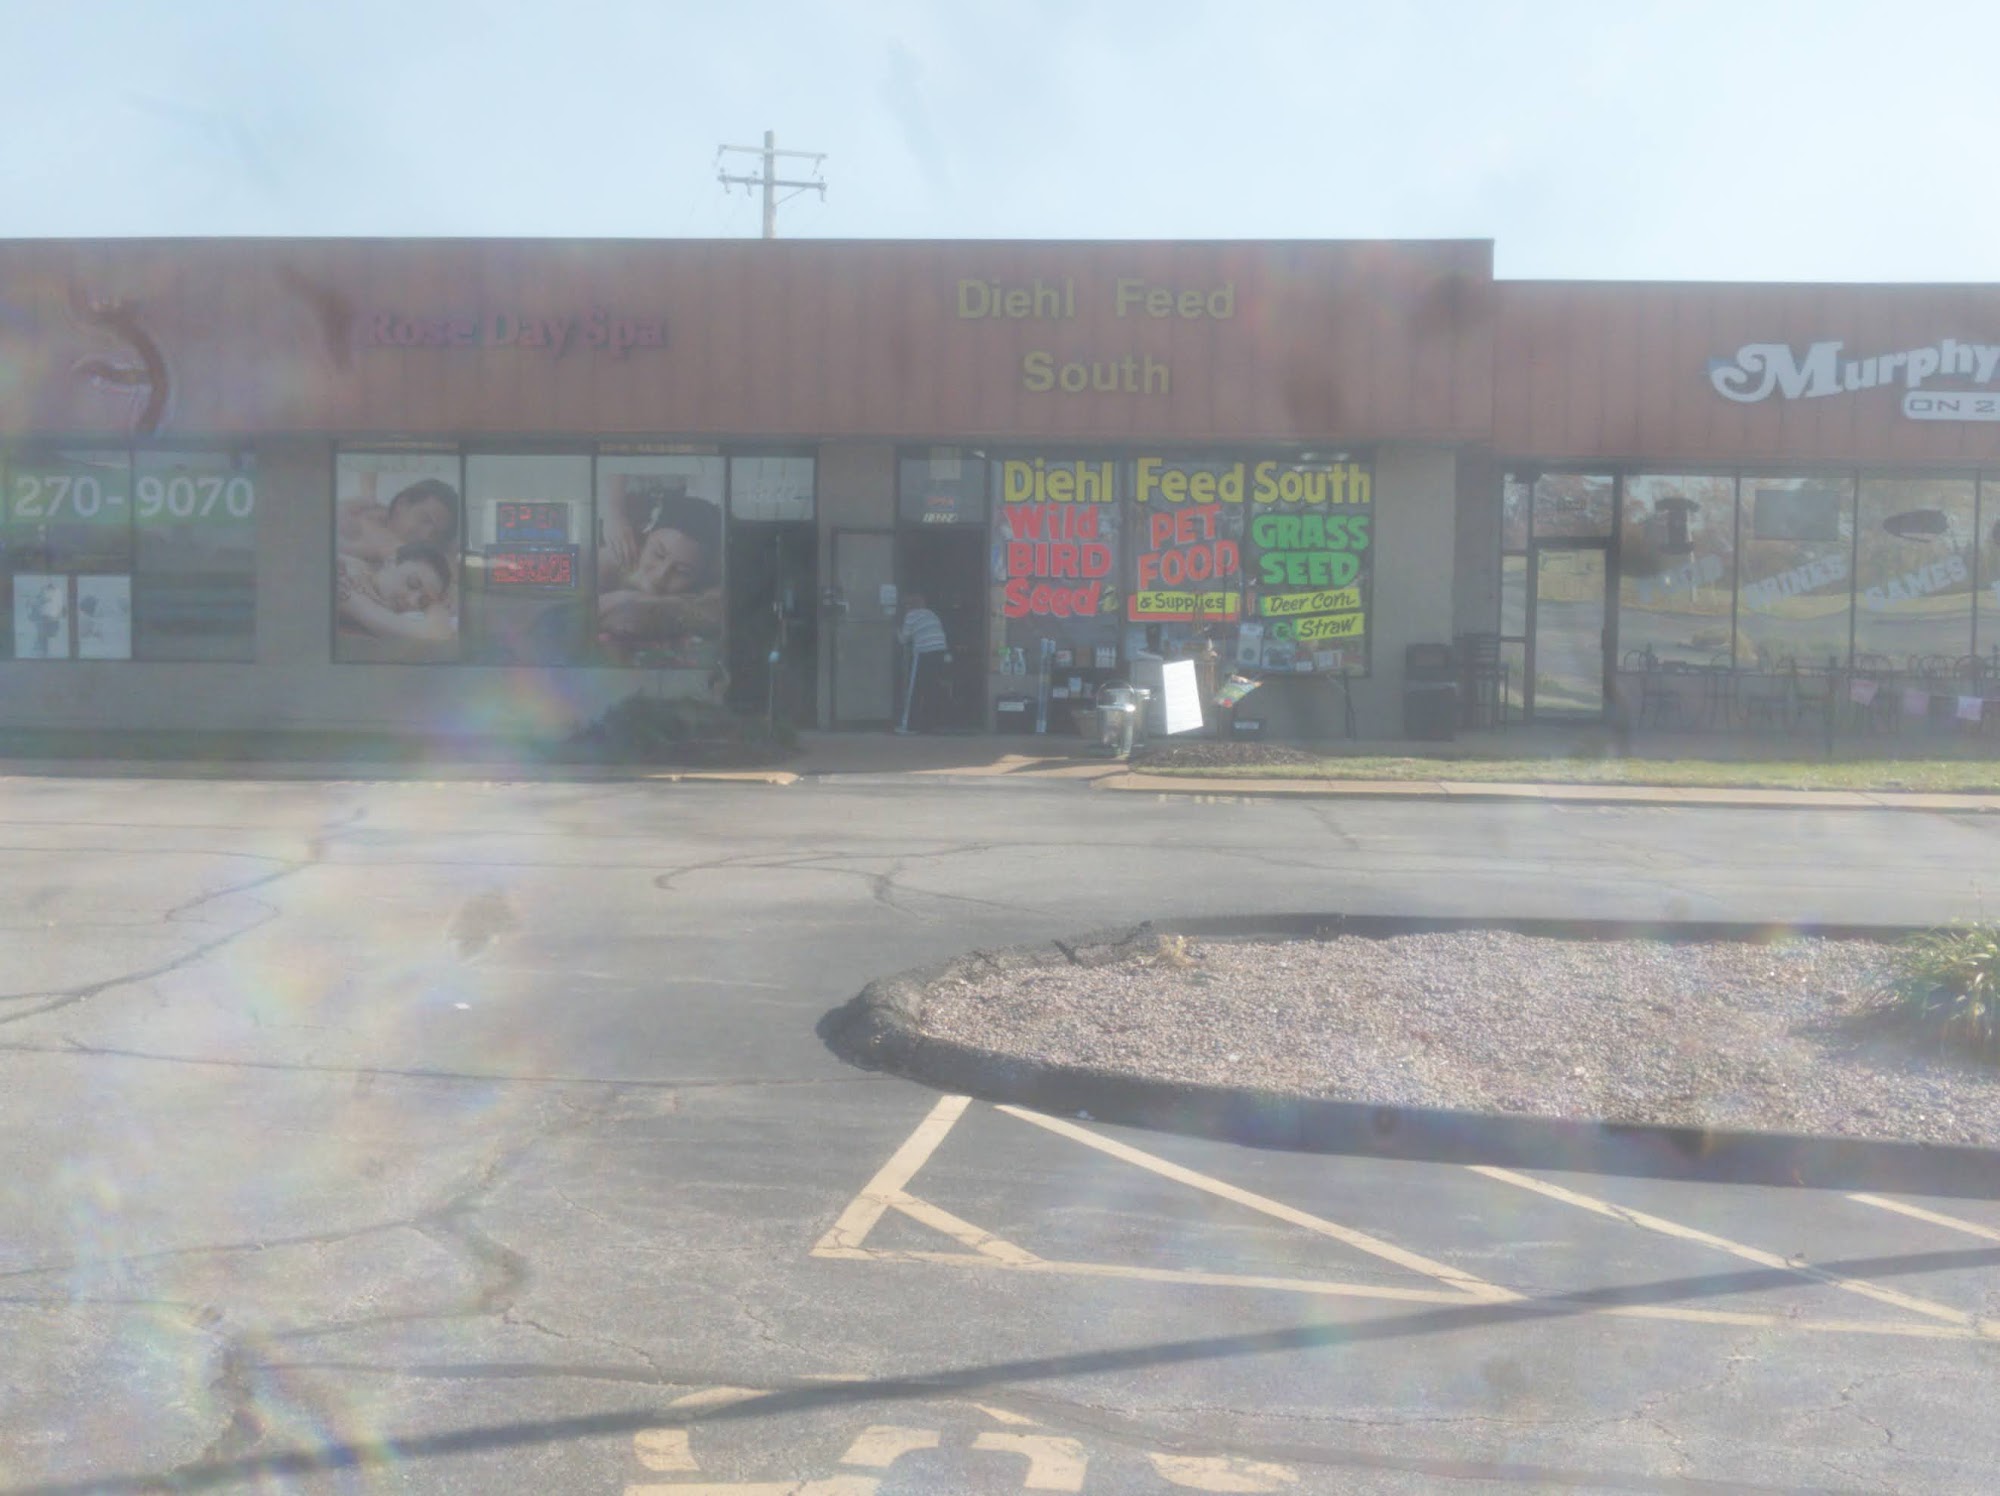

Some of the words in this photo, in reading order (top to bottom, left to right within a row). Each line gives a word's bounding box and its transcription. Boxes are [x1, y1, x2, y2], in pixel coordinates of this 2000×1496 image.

[957, 279, 1076, 319] Diehl
[1116, 278, 1237, 320] Feed
[362, 309, 478, 346] Rose
[484, 312, 571, 361] Day
[580, 306, 666, 358] Spa
[1023, 352, 1171, 394] South
[1909, 399, 1960, 413] ON
[1002, 457, 1115, 504] Diehl
[1136, 456, 1245, 504] Feed
[1252, 459, 1372, 504] South
[1003, 502, 1100, 542] Wild
[1150, 502, 1222, 552] PET
[1251, 513, 1372, 552] GRASS
[1006, 542, 1112, 579] BIRD
[1137, 539, 1241, 591] FOOD
[1258, 551, 1361, 588] SEED
[1002, 577, 1103, 618] Seed
[1155, 592, 1225, 611] Supplies
[1865, 555, 1967, 611] GAMES
[1270, 594, 1309, 613] Deer
[1299, 616, 1357, 638] Straw
